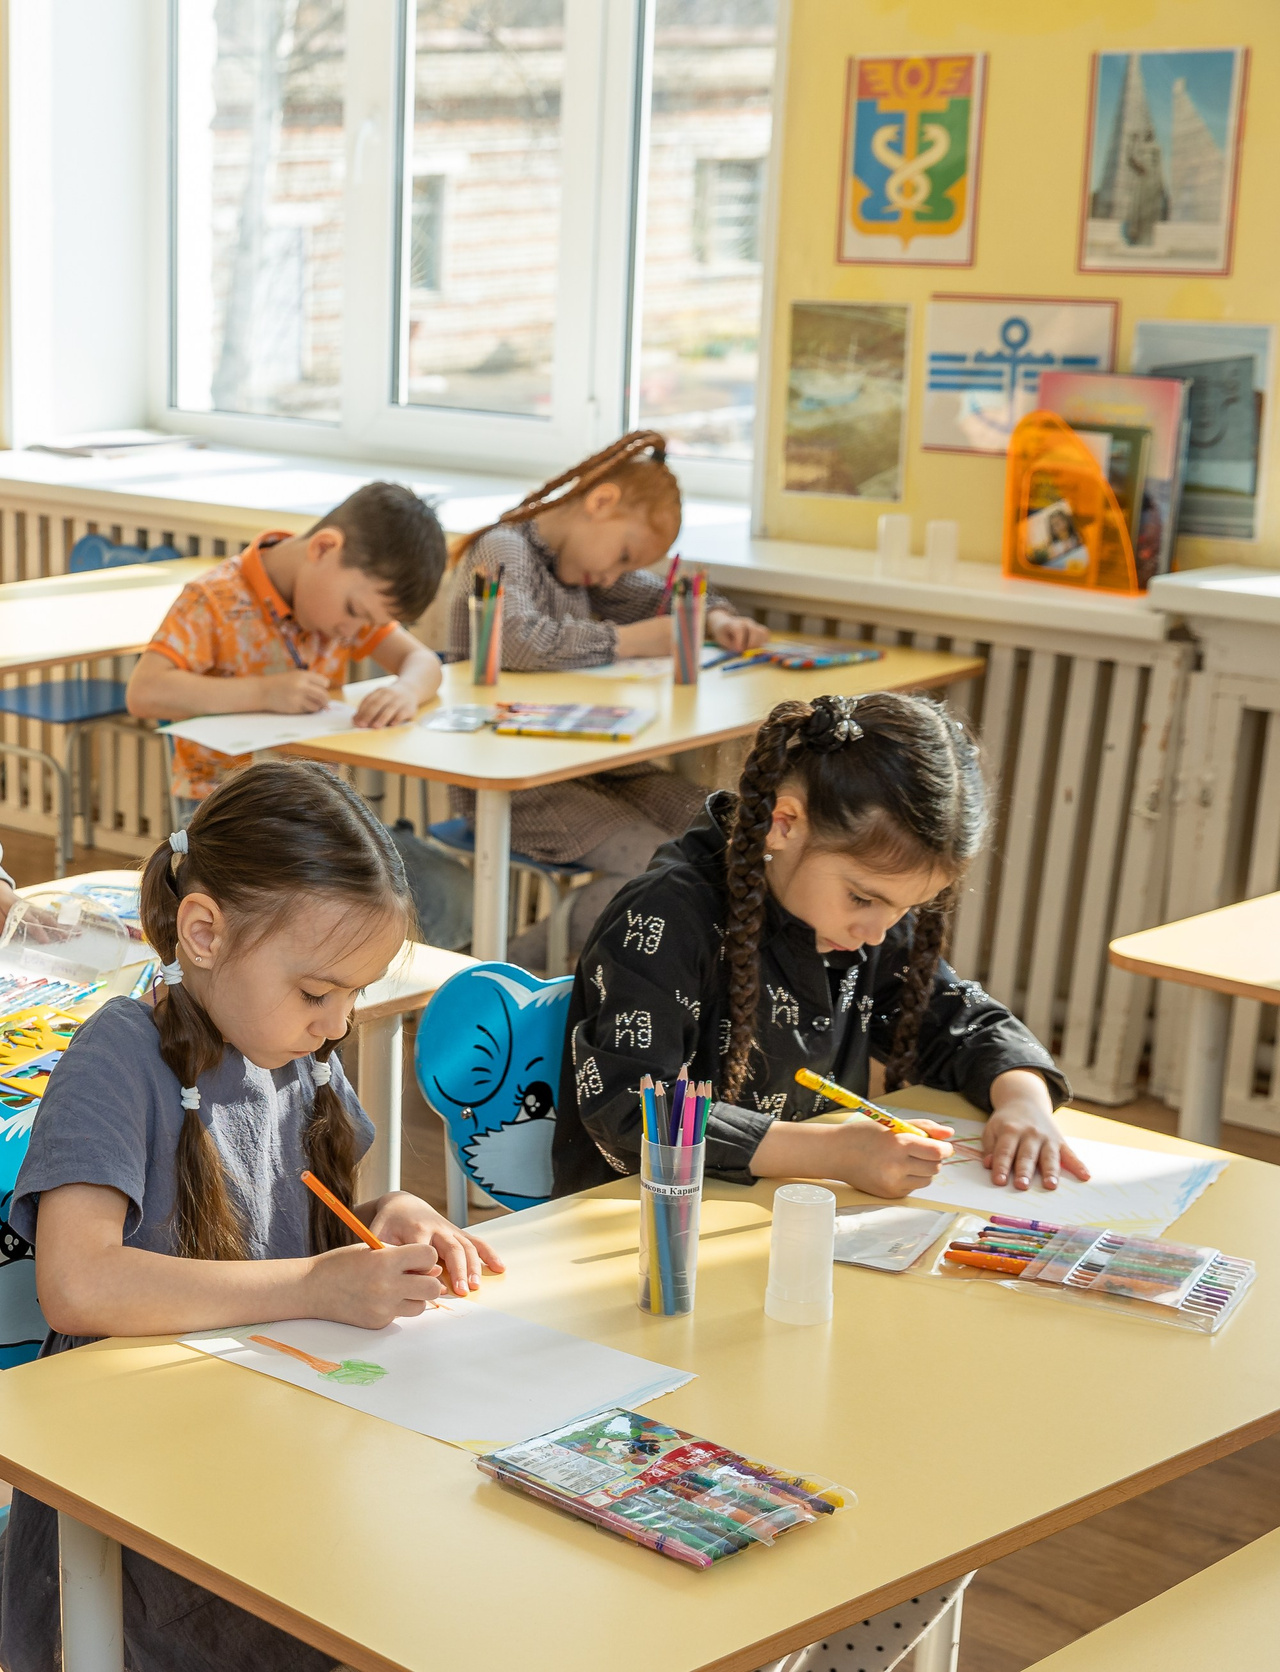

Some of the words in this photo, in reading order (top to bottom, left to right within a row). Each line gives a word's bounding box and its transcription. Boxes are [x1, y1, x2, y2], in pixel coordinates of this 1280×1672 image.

[627, 910, 665, 933] wa
[623, 930, 661, 955] ng
[615, 1010, 651, 1027] wa
[615, 1027, 652, 1049] ng
